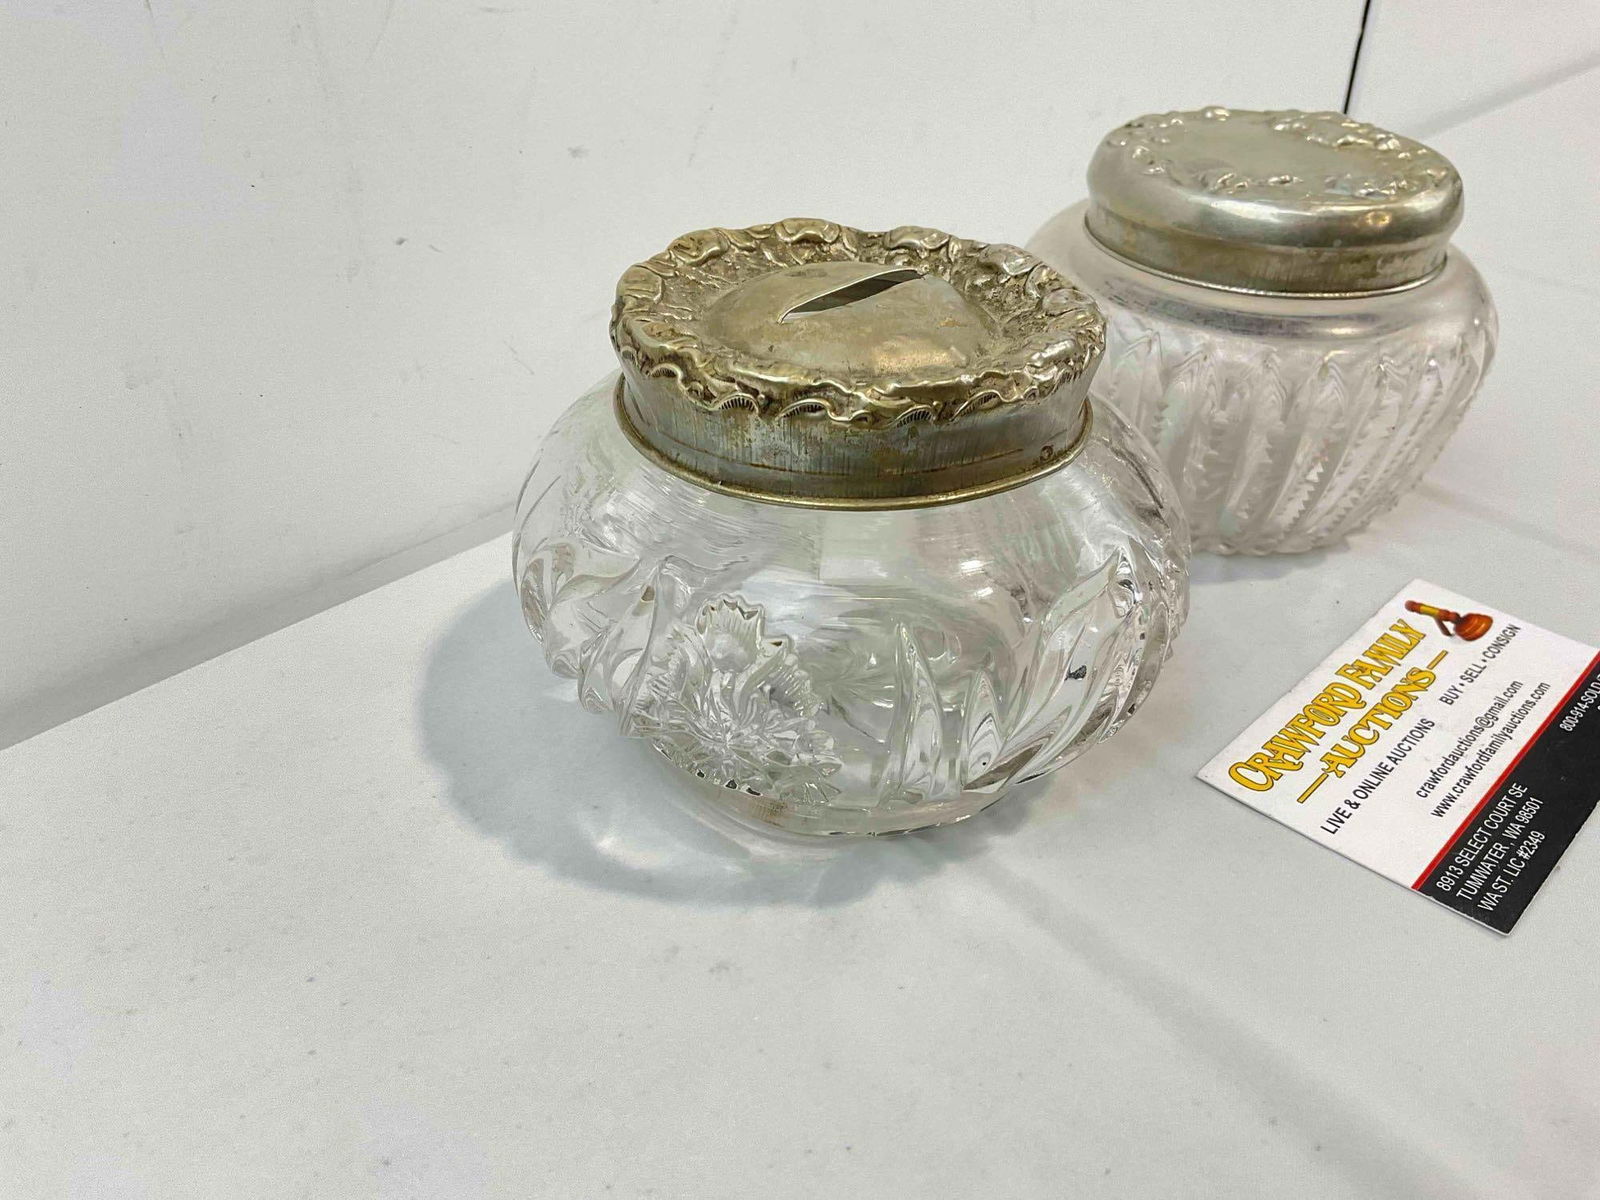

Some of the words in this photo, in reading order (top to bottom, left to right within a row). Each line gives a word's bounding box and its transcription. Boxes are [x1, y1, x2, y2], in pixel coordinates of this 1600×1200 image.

[1439, 685, 1464, 706] BUY
[1460, 662, 1487, 684] SELL
[1482, 624, 1521, 659] CONSIGN
[1321, 806, 1352, 834] LIVE
[1346, 798, 1361, 811] &
[1354, 761, 1394, 800] ONLINE
[1387, 717, 1435, 766] AUCTIONS
[1416, 680, 1523, 799] crawfordauctions@gmail.com
[1431, 682, 1551, 818] www.crawfordfamilyauctions.com
[1436, 865, 1464, 892] 8913
[1455, 827, 1492, 866] SELECT
[1484, 795, 1517, 830] COURT
[1508, 782, 1528, 798] SE
[1477, 892, 1503, 912] WA
[1492, 876, 1514, 894] ST.
[1503, 857, 1525, 878] LIC
[1516, 830, 1546, 860] #2349
[1502, 822, 1526, 840] WA
[1515, 797, 1543, 824] 98501
